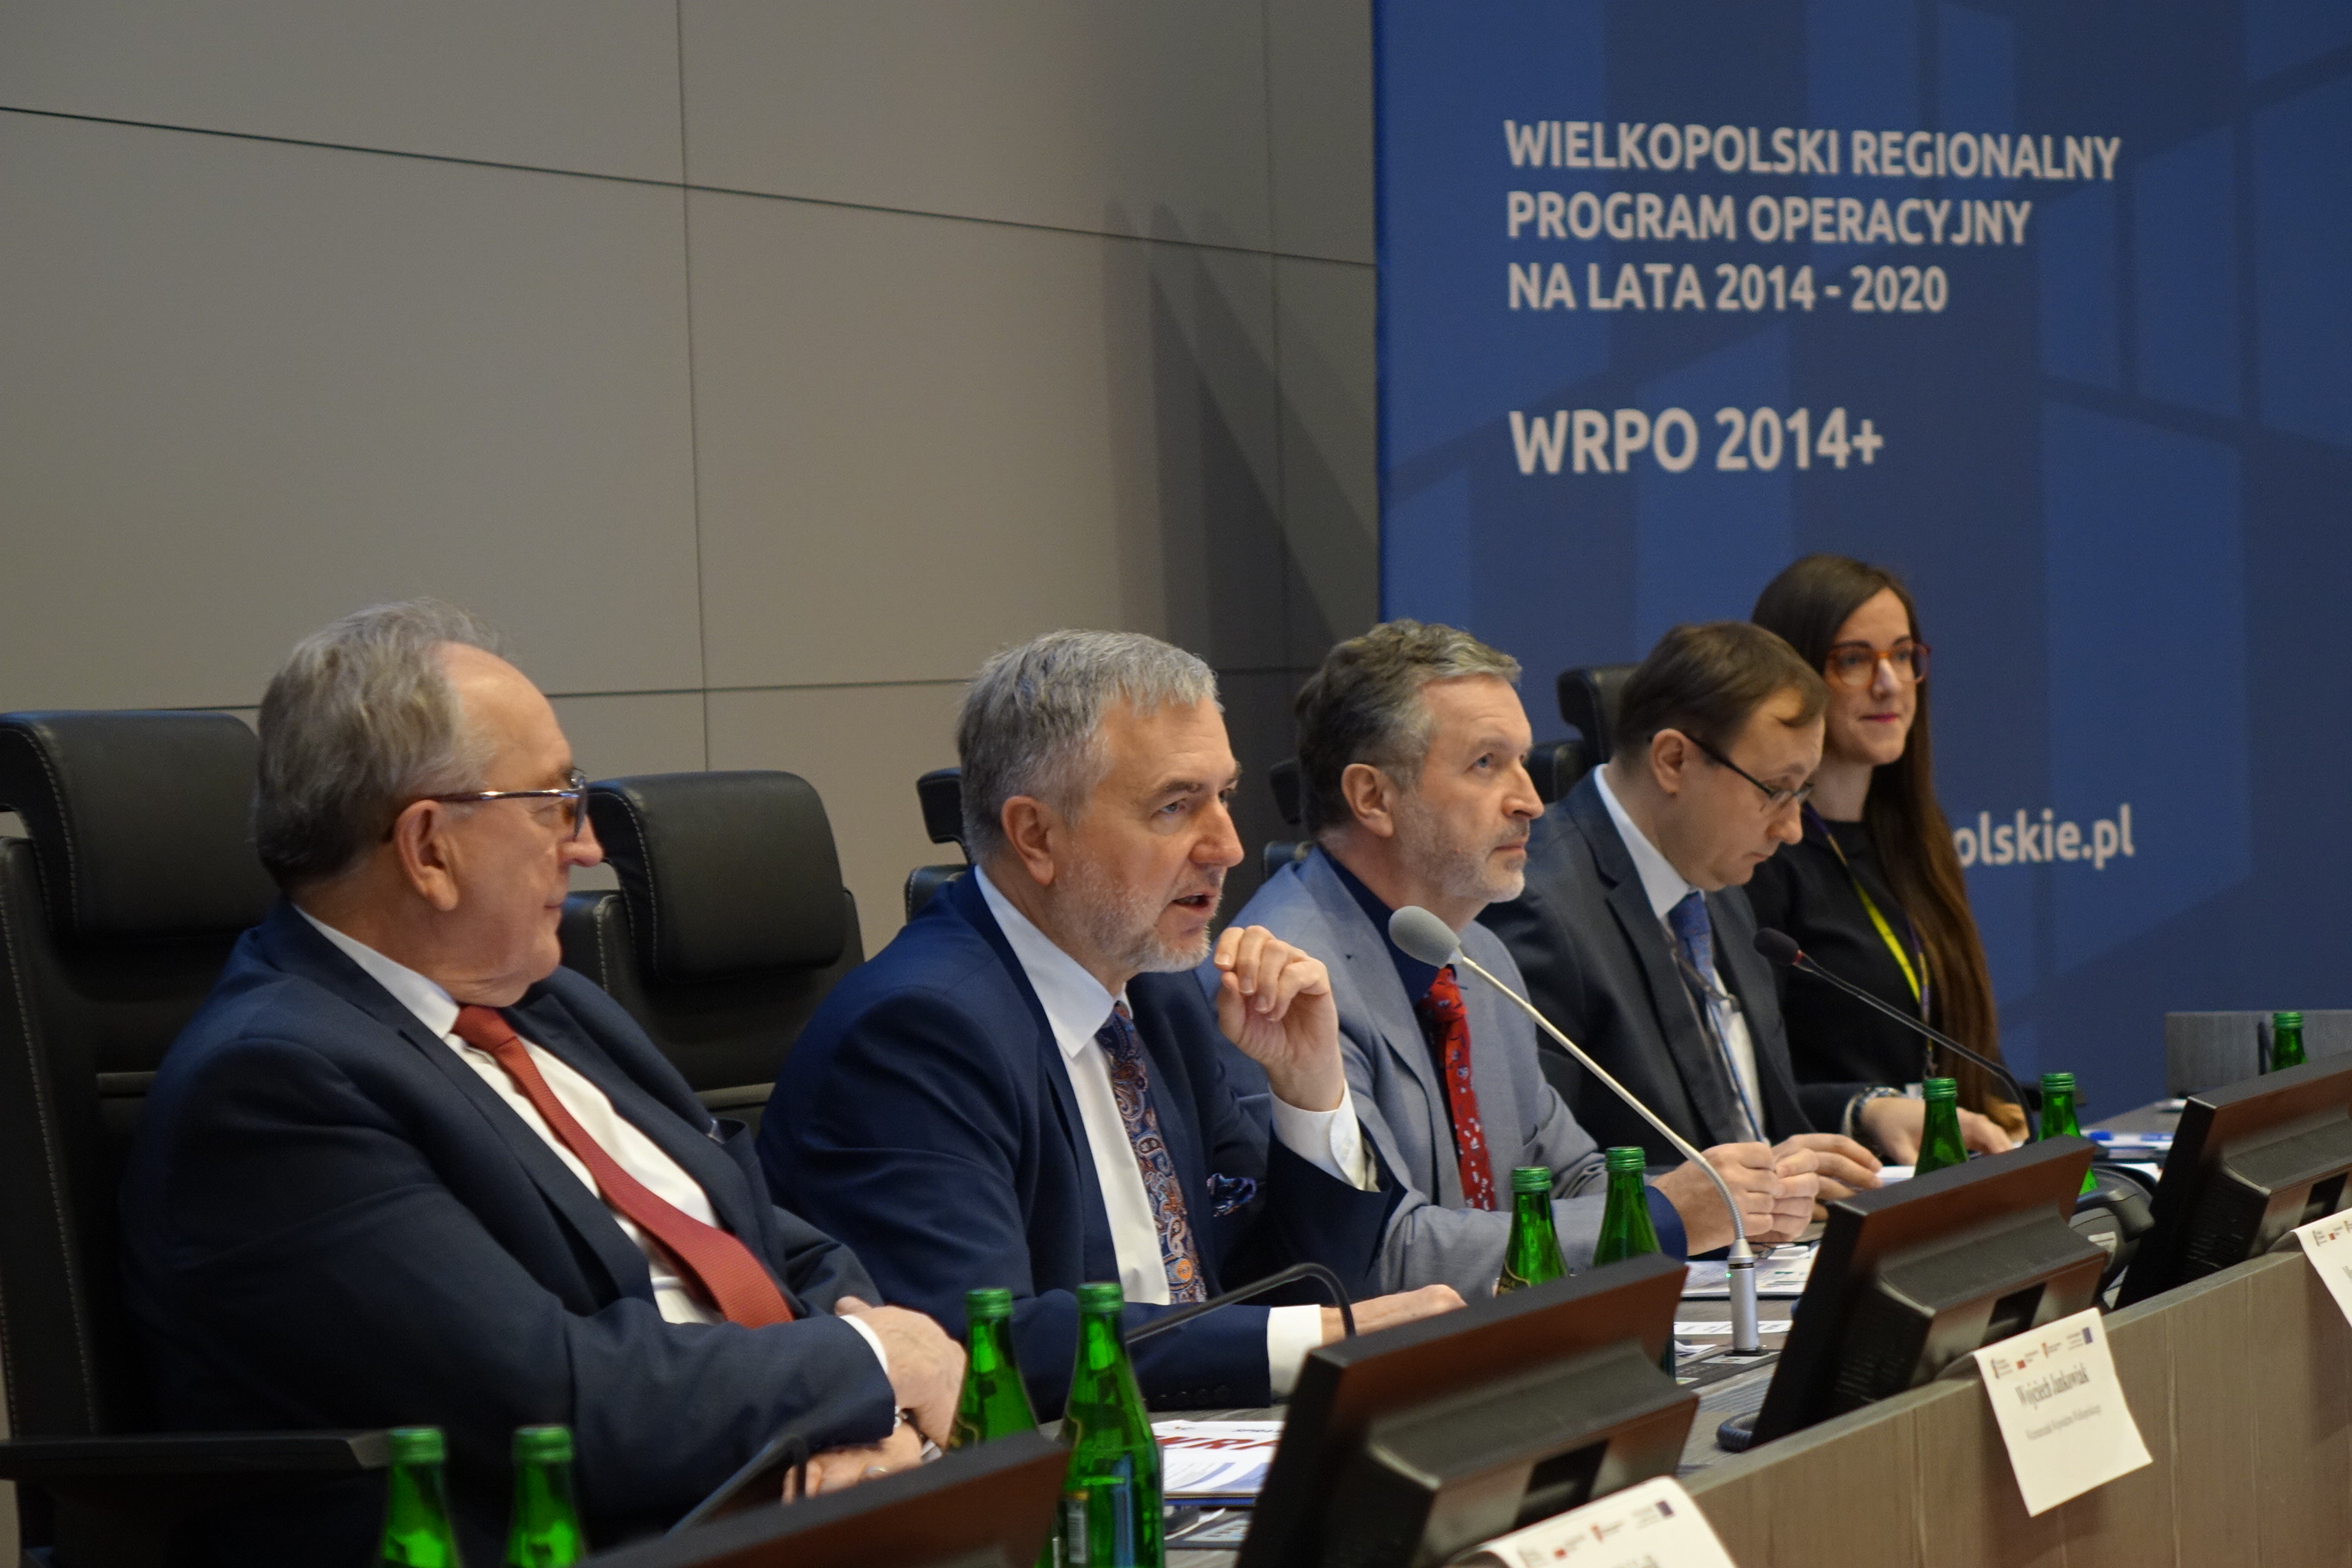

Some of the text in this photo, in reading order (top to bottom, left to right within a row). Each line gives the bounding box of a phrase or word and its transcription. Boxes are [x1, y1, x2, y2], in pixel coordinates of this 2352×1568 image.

[1504, 119, 2121, 180] WIELKOPOLSKI REGIONALNY
[1508, 191, 2031, 245] PROGRAM OPERACYJNY
[1509, 262, 1577, 309] NA
[1588, 263, 1706, 309] LATA
[1716, 263, 1816, 311] 2014
[1851, 265, 1948, 312] 2020
[1509, 407, 1883, 475] WRPO 2014+
